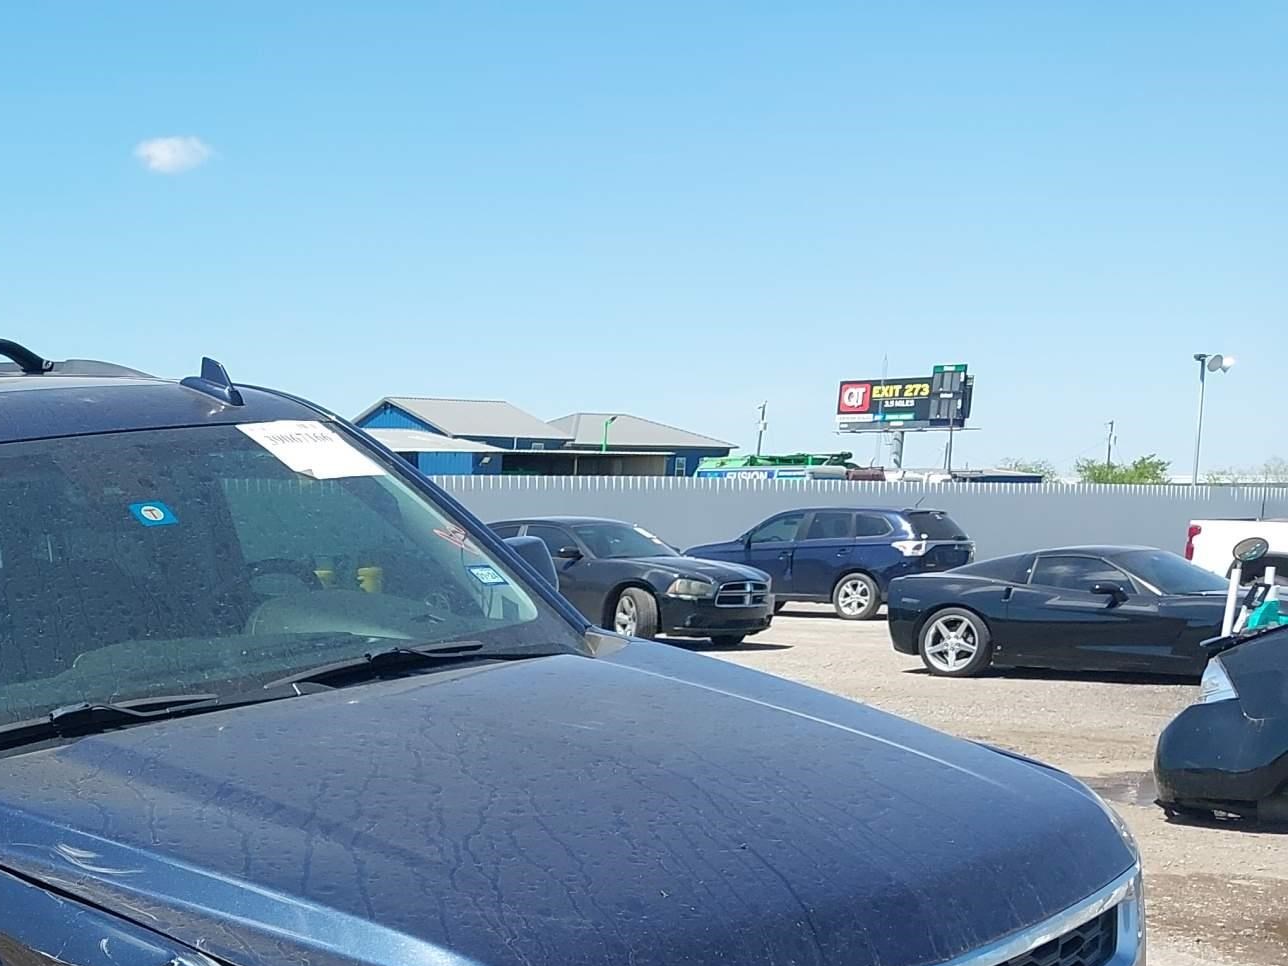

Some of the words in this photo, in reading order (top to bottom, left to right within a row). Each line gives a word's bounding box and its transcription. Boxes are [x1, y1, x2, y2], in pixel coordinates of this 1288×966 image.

[843, 387, 866, 408] QT
[872, 385, 902, 398] EXIT
[903, 383, 930, 397] 273
